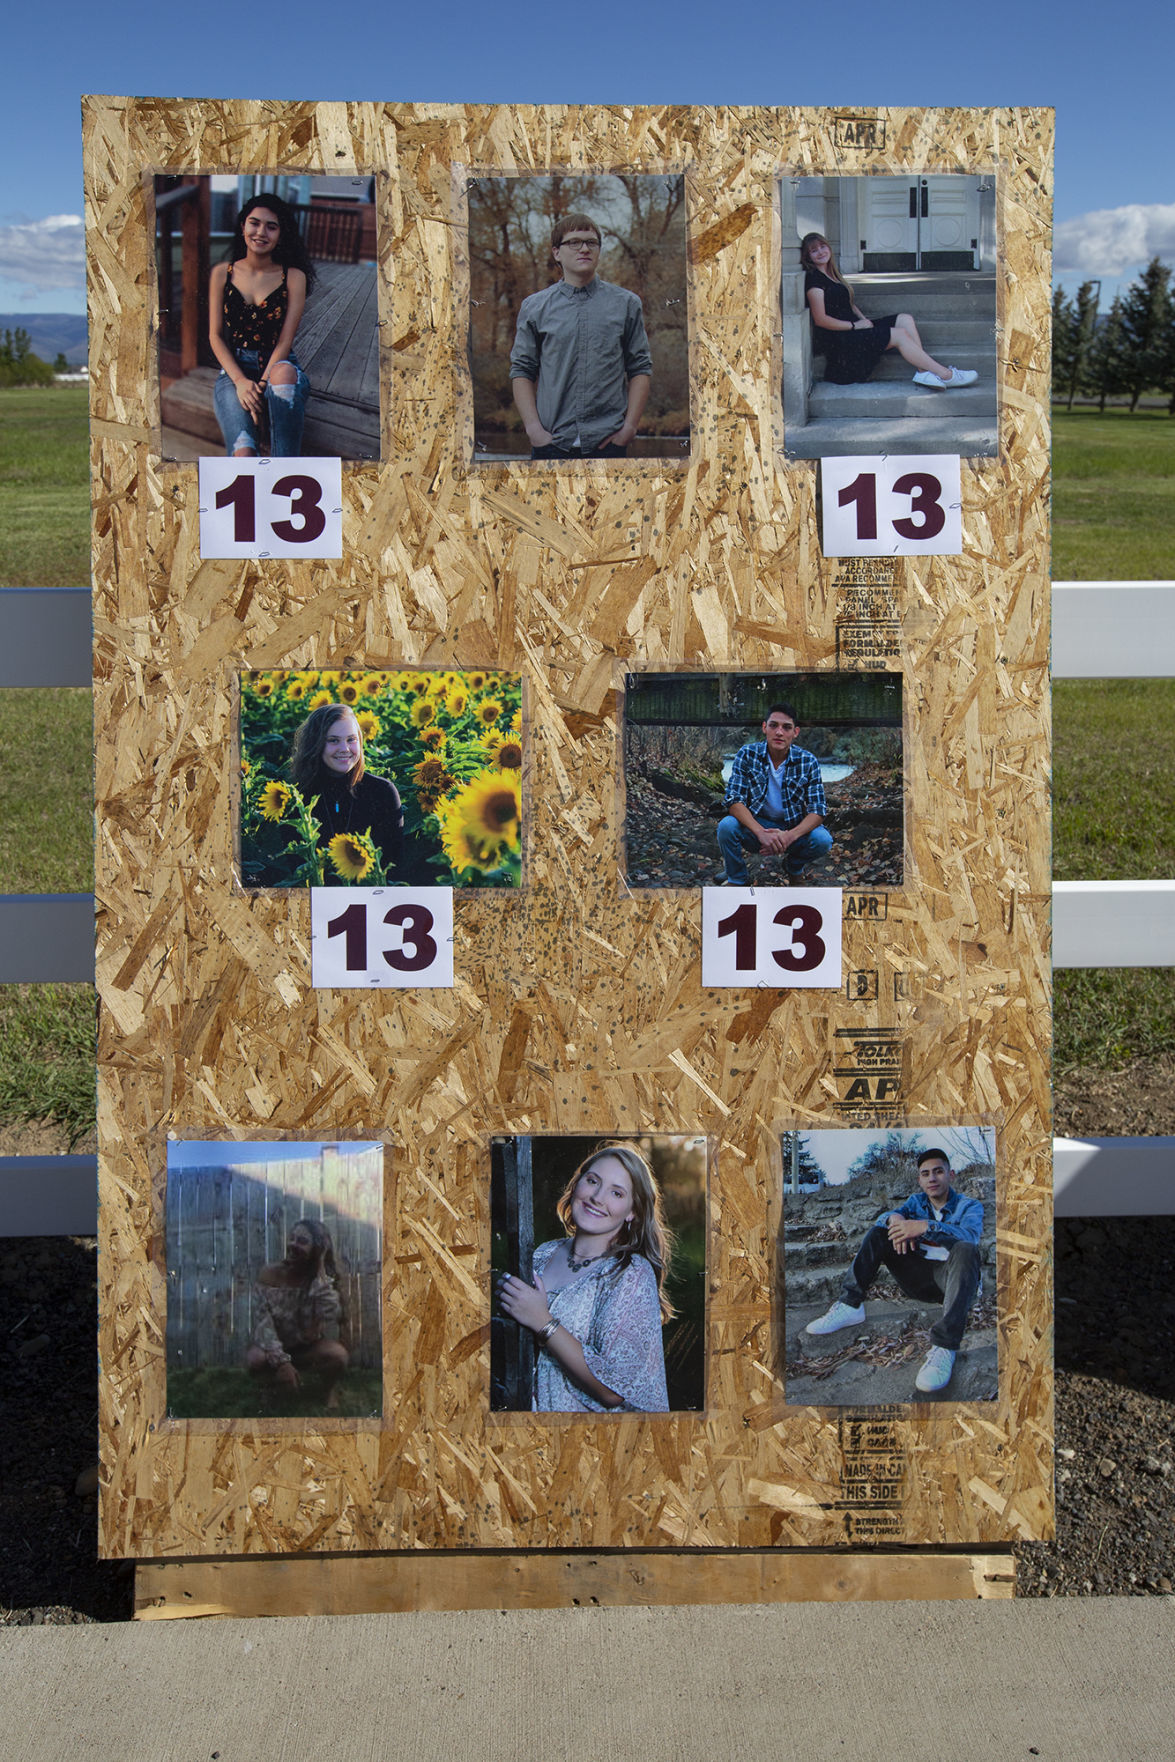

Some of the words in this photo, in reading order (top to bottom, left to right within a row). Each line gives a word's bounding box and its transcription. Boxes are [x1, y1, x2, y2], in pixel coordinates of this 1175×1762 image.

[844, 122, 876, 144] APR
[216, 475, 325, 543] 13
[838, 473, 945, 540] 13
[846, 896, 879, 916] APR
[328, 904, 437, 971] 13
[718, 904, 825, 971] 13
[844, 1078, 900, 1101] AP
[870, 1485, 898, 1499] SIDE
